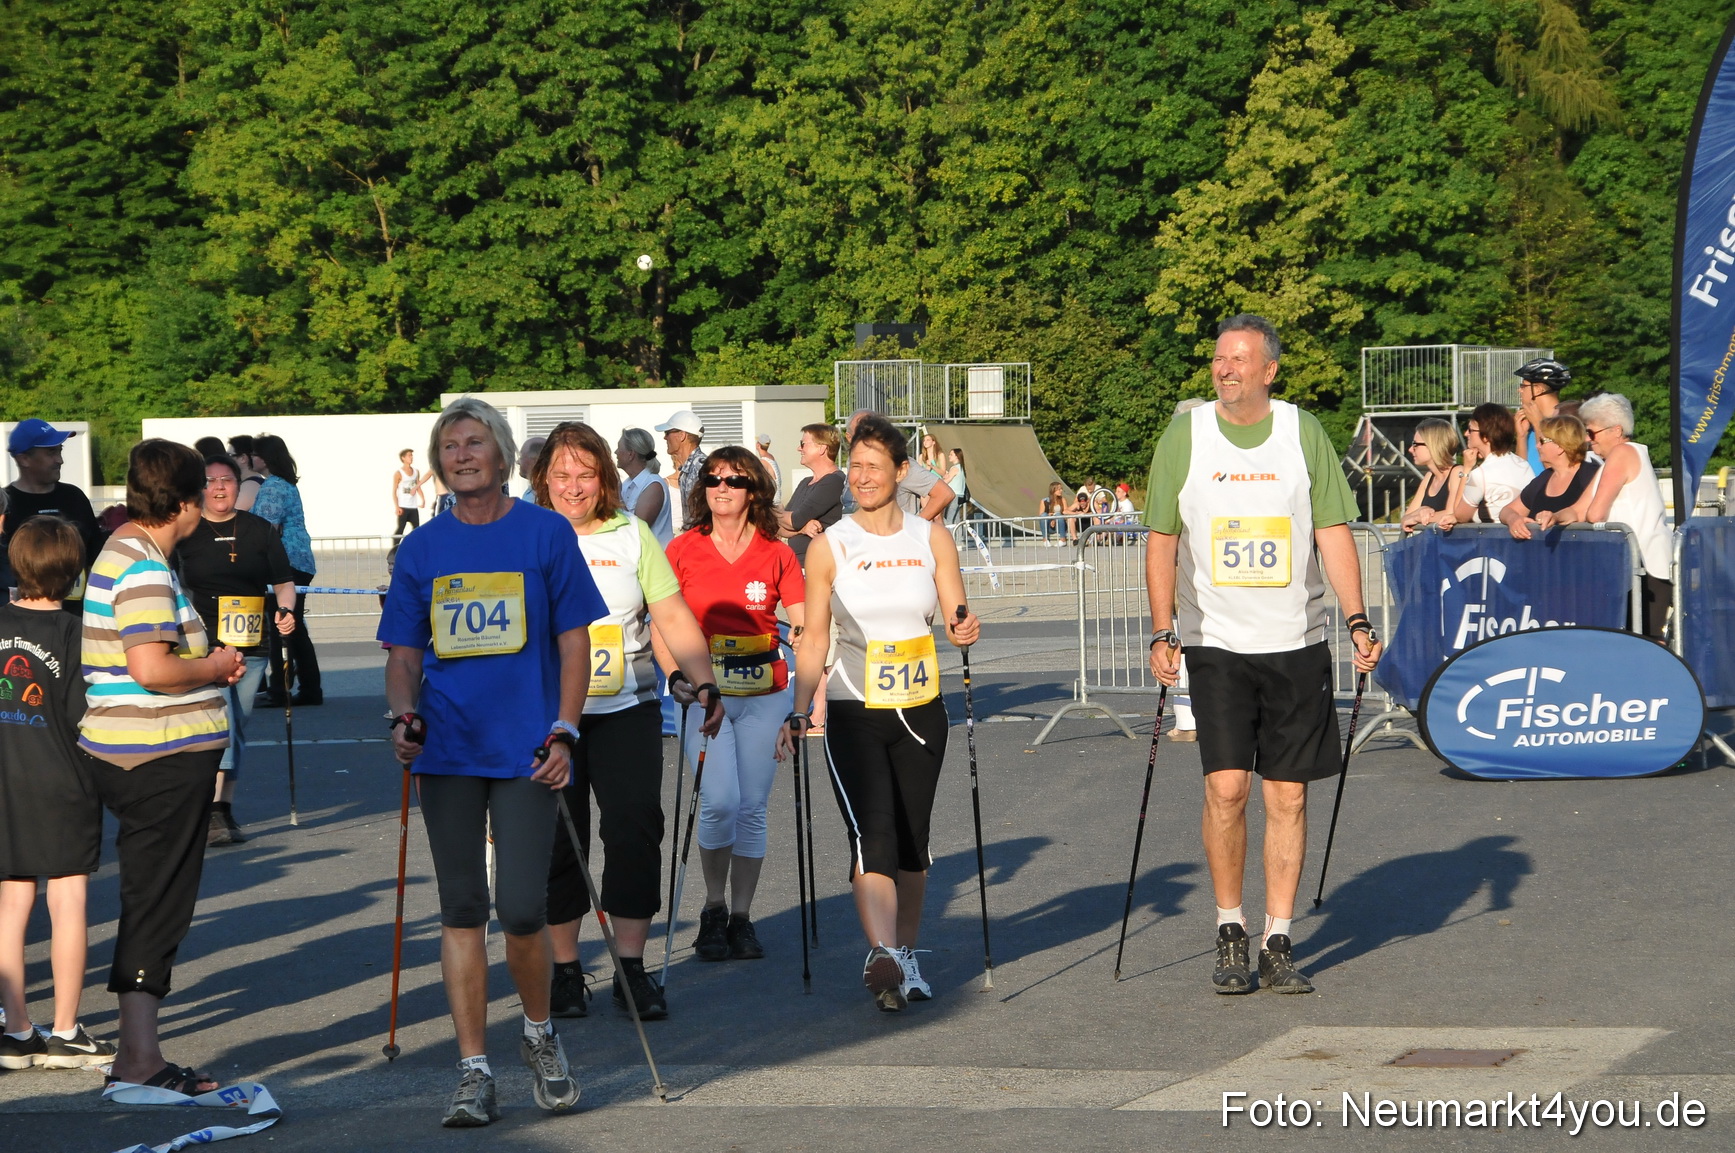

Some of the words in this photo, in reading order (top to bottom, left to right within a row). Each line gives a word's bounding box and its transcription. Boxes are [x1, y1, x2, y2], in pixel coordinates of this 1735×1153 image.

[1230, 473, 1280, 481] KLEBL
[876, 558, 926, 568] KLEBL
[1223, 541, 1277, 568] 518
[443, 600, 511, 636] 704
[745, 603, 767, 611] caritas
[221, 614, 261, 634] 1082
[594, 649, 611, 676] 2
[877, 660, 929, 691] 514
[1496, 692, 1669, 730] Fischer
[1513, 727, 1657, 748] AUTOMOBILE
